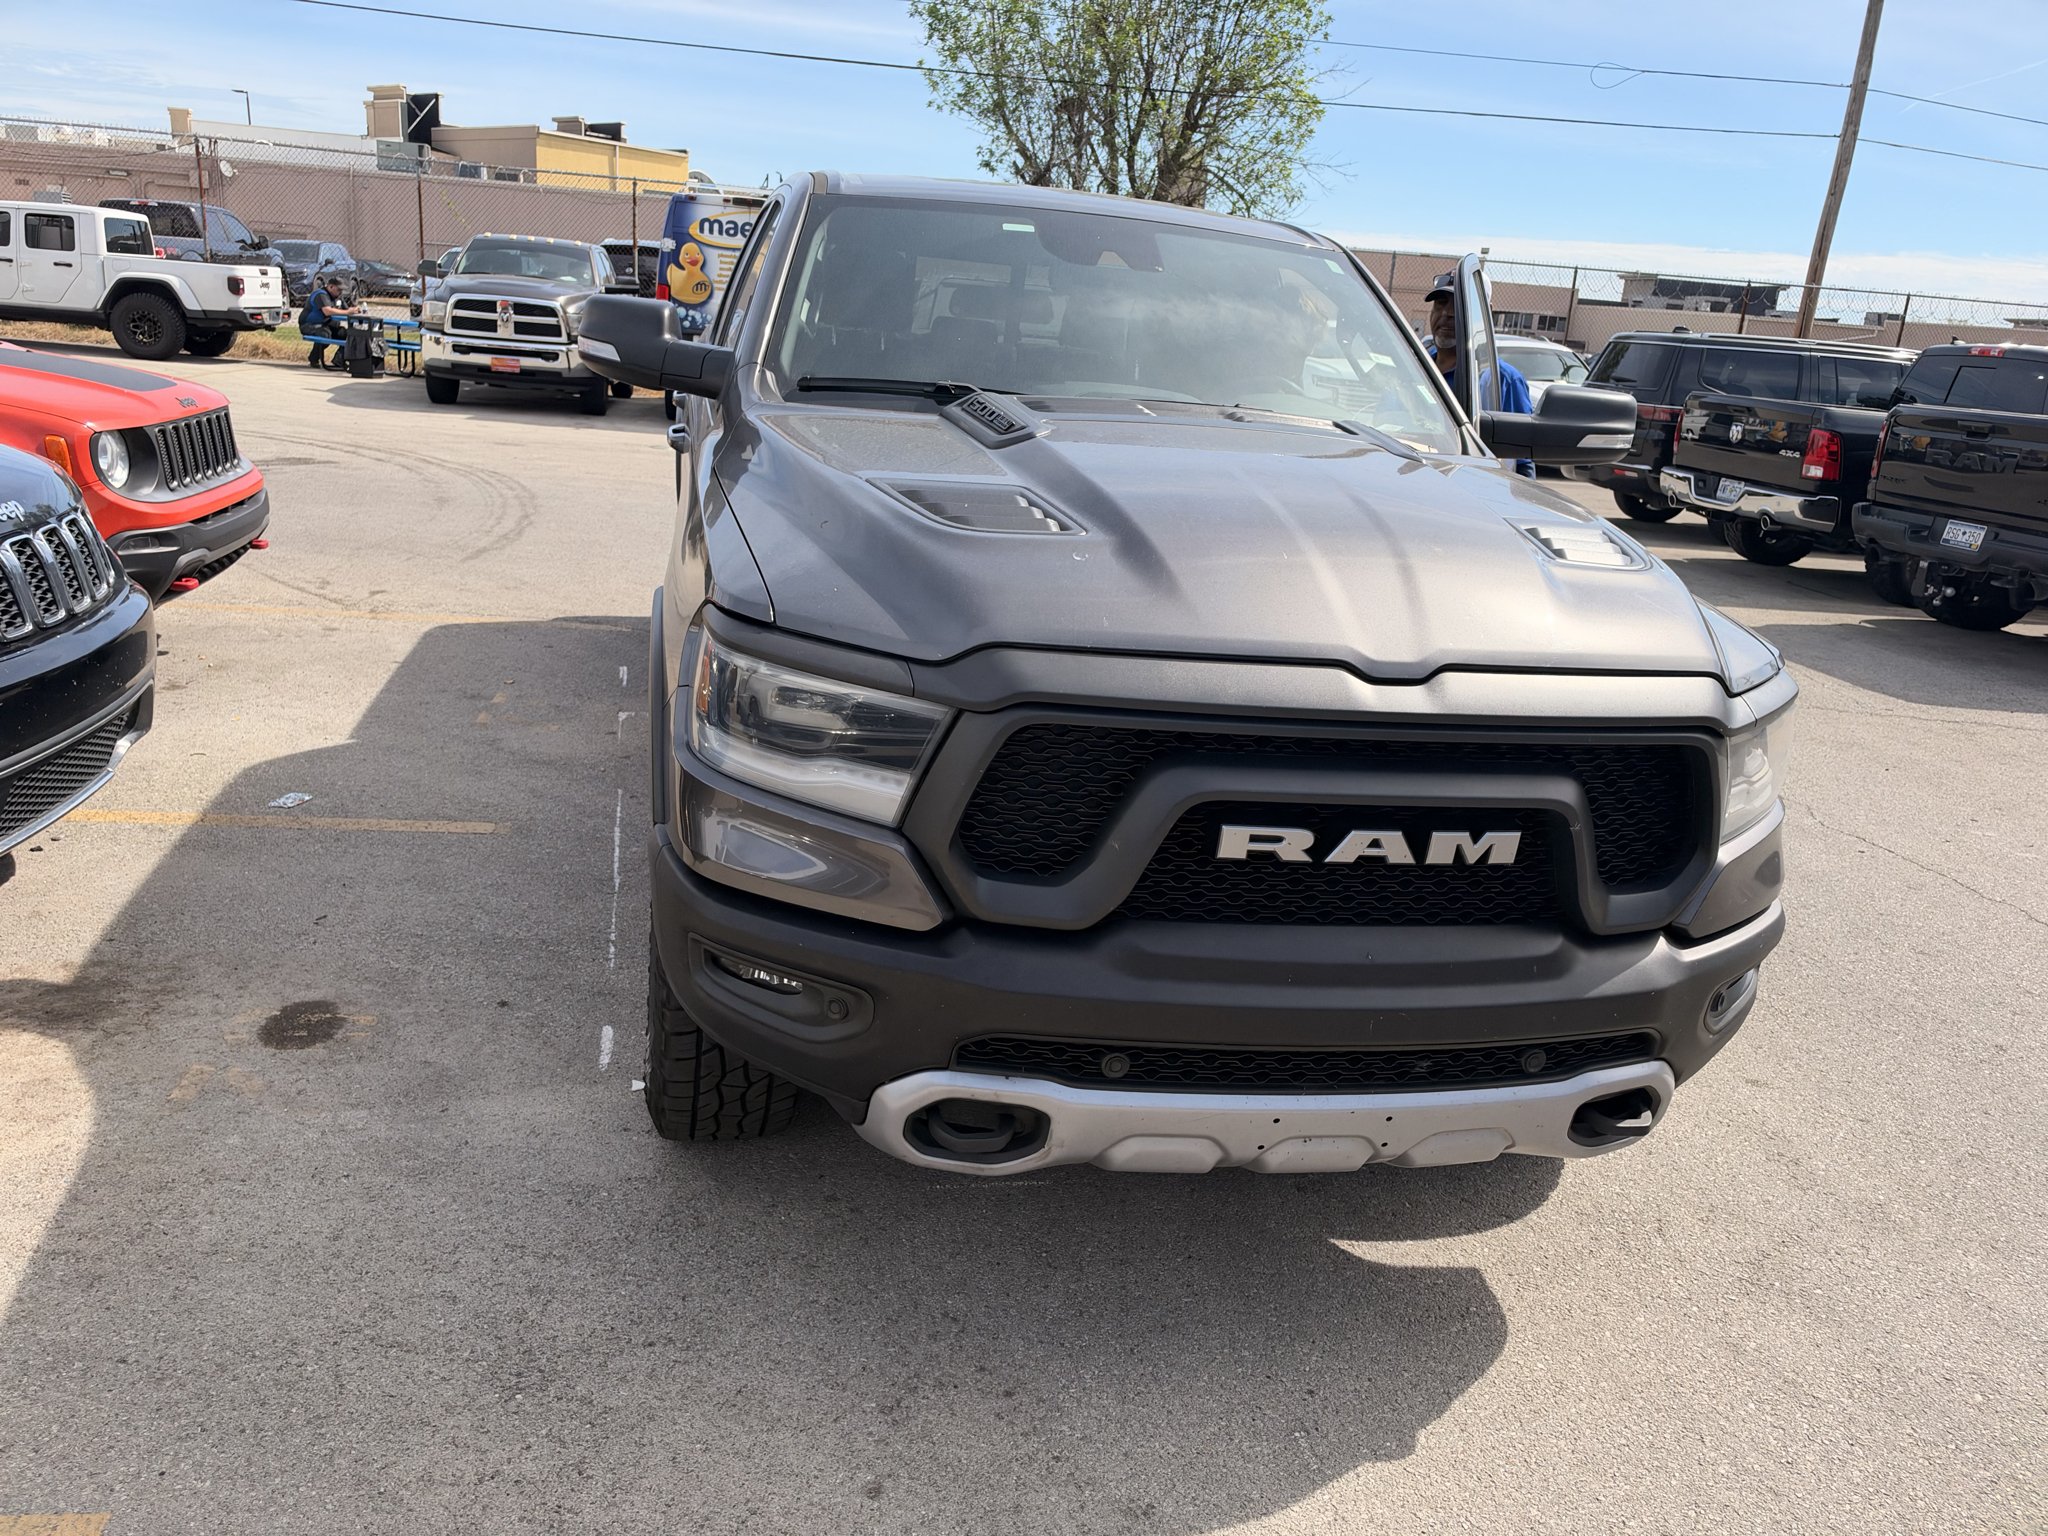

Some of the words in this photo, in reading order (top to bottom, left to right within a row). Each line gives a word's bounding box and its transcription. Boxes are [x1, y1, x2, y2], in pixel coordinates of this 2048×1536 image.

[1925, 448, 2020, 473] RAM
[0, 500, 25, 521] eep
[1945, 526, 1961, 540] RSG
[1965, 531, 1981, 543] 350
[1215, 825, 1521, 865] RAM
